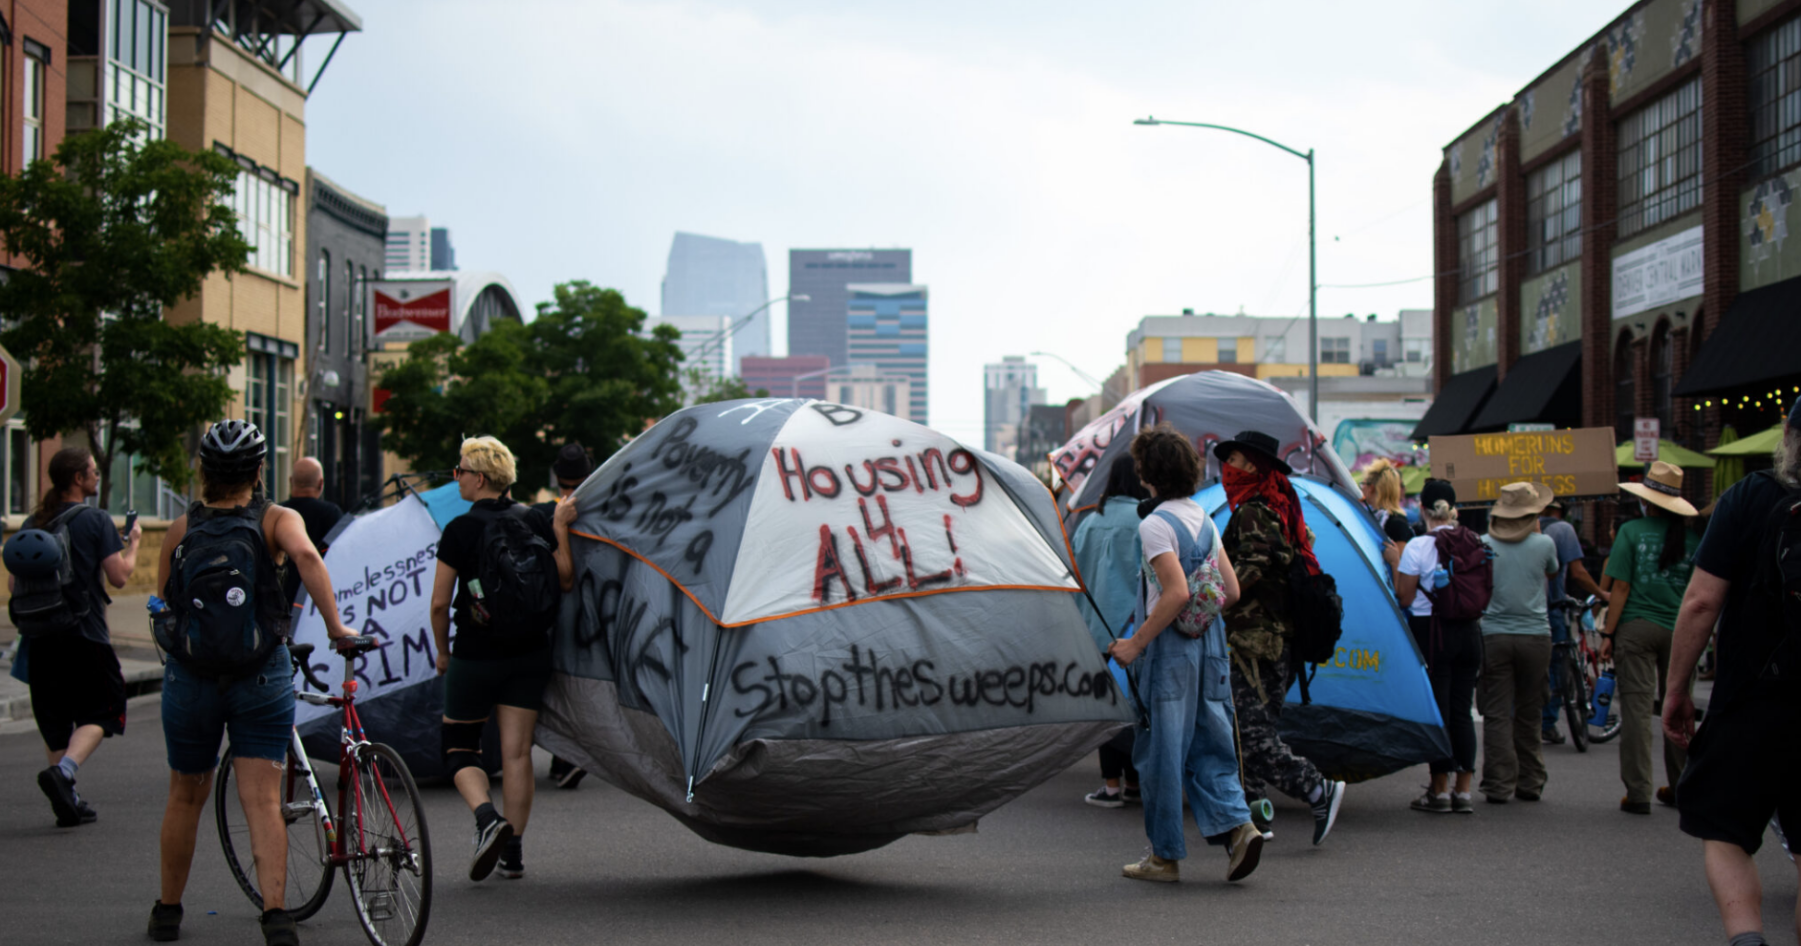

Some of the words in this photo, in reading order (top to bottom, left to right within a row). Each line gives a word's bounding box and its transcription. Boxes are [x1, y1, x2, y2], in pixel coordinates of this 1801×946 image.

[377, 303, 449, 319] Budweiser
[1474, 434, 1576, 456] HOMERUNS
[1508, 455, 1546, 476] FOR
[771, 439, 984, 508] Housing
[857, 494, 901, 560] 4
[811, 514, 969, 604] ALL!
[367, 566, 428, 617] NOT
